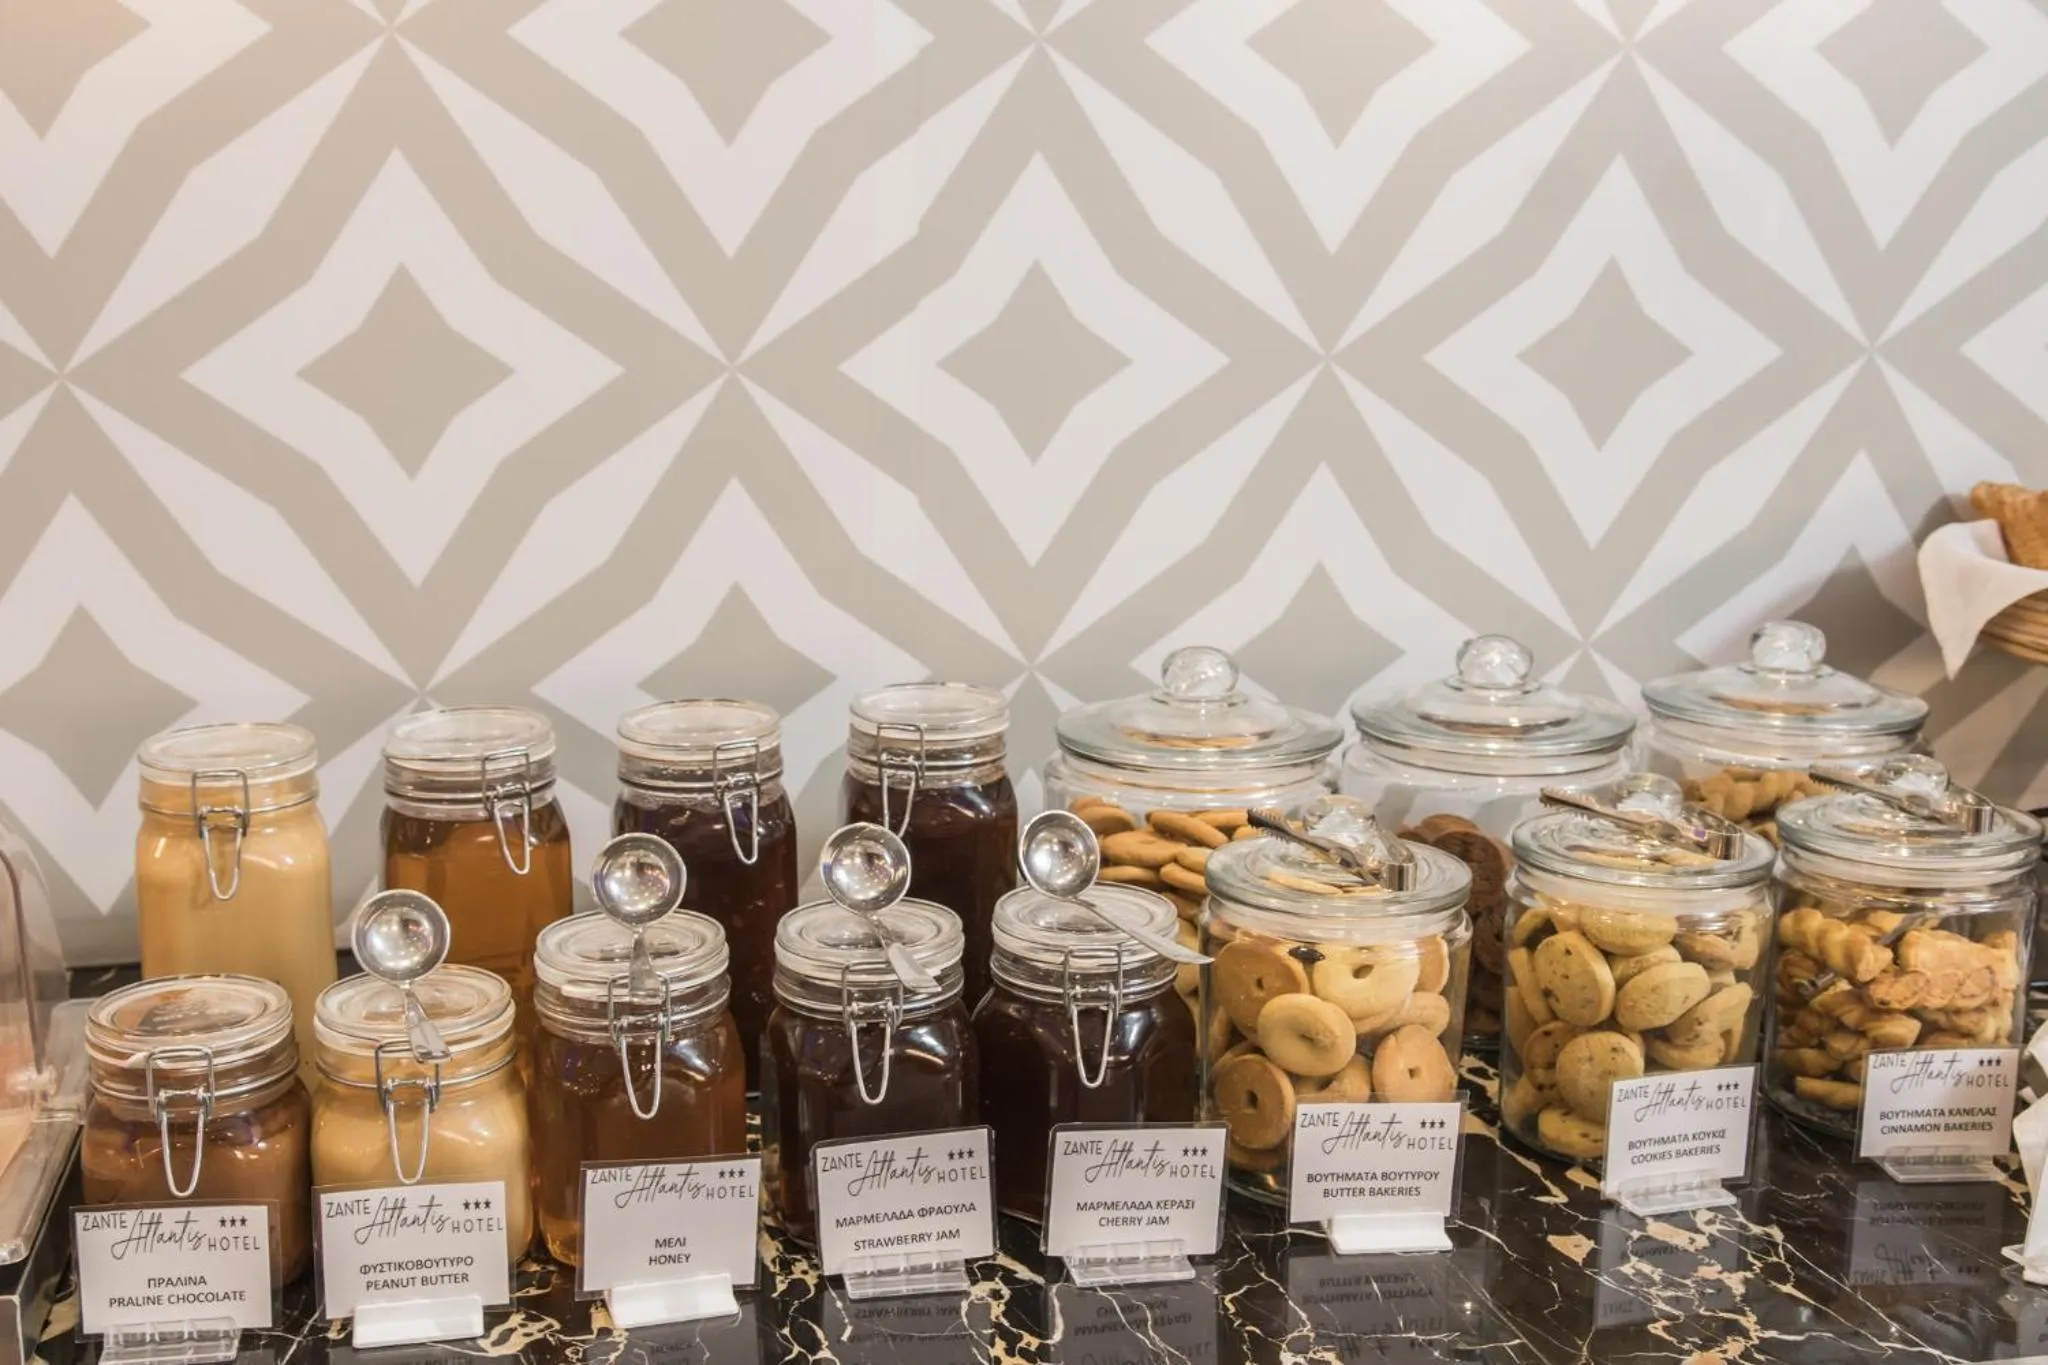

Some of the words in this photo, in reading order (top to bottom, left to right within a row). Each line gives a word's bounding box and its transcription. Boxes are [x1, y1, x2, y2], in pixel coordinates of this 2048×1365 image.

[1872, 1054, 1906, 1069] ZANTE
[1966, 1074, 2008, 1088] HOTEL
[1617, 1085, 1650, 1102] ZANTE
[1706, 1097, 1746, 1110] HOTEL
[1880, 1108, 1945, 1120] ΒΟΥΤΗΜΑΤΑ
[1300, 1112, 1340, 1128] ZANTE
[1407, 1137, 1454, 1150] HOTEL
[1880, 1123, 1941, 1135] CINNAMON
[1943, 1121, 1993, 1132] BAKERIES
[1628, 1133, 1689, 1151] ΒΟΥΤΗΜΑΤΑ
[1063, 1140, 1102, 1156] ZANTE
[1169, 1164, 1216, 1179] HOTEL
[1631, 1150, 1673, 1165] COOKIES
[1675, 1144, 1721, 1158] BAKERIES
[821, 1152, 863, 1172] ZANTE
[937, 1166, 986, 1183] HOTEL
[1307, 1172, 1378, 1183] ΒΟΥΤΗΜΑΤΑ
[1381, 1171, 1440, 1181] ΒΟΥΤΥΡΟΥ
[590, 1168, 632, 1184] ZANTE
[706, 1185, 754, 1200] HOTEL
[1323, 1187, 1366, 1198] BUTTER
[1368, 1186, 1421, 1196] BAKERIES
[1076, 1200, 1153, 1212] ΜΑΡΜΕΛΑΔΑ
[1156, 1199, 1195, 1210] ΚΕΡΑΣΙ
[325, 1198, 371, 1218] ZANTE
[451, 1217, 503, 1233] HOTEL
[835, 1211, 915, 1229] ΜΑΡΜΕΛΑΔΑ
[917, 1202, 977, 1218] ΦΡΑΟΥΛΑ
[1098, 1216, 1144, 1227] CHERRY
[1145, 1215, 1170, 1226] JAM
[82, 1212, 128, 1231] ZANTE
[208, 1236, 260, 1252] HOTEL
[854, 1231, 933, 1251] STRAWBERRY
[935, 1228, 960, 1241] JAM
[655, 1237, 686, 1249] ΜΕΛΙ
[360, 1255, 474, 1275] ΦΥΣΤΙΚΟΒΟΥΤΥΡΟ
[648, 1253, 691, 1266] HONEY
[147, 1275, 207, 1289] ΠΡΑΛΙΝΑ
[366, 1276, 416, 1291] PEANUT
[421, 1272, 469, 1286] BUTTER
[109, 1294, 164, 1308] PRALINE
[168, 1290, 246, 1305] CHOCOLATE
